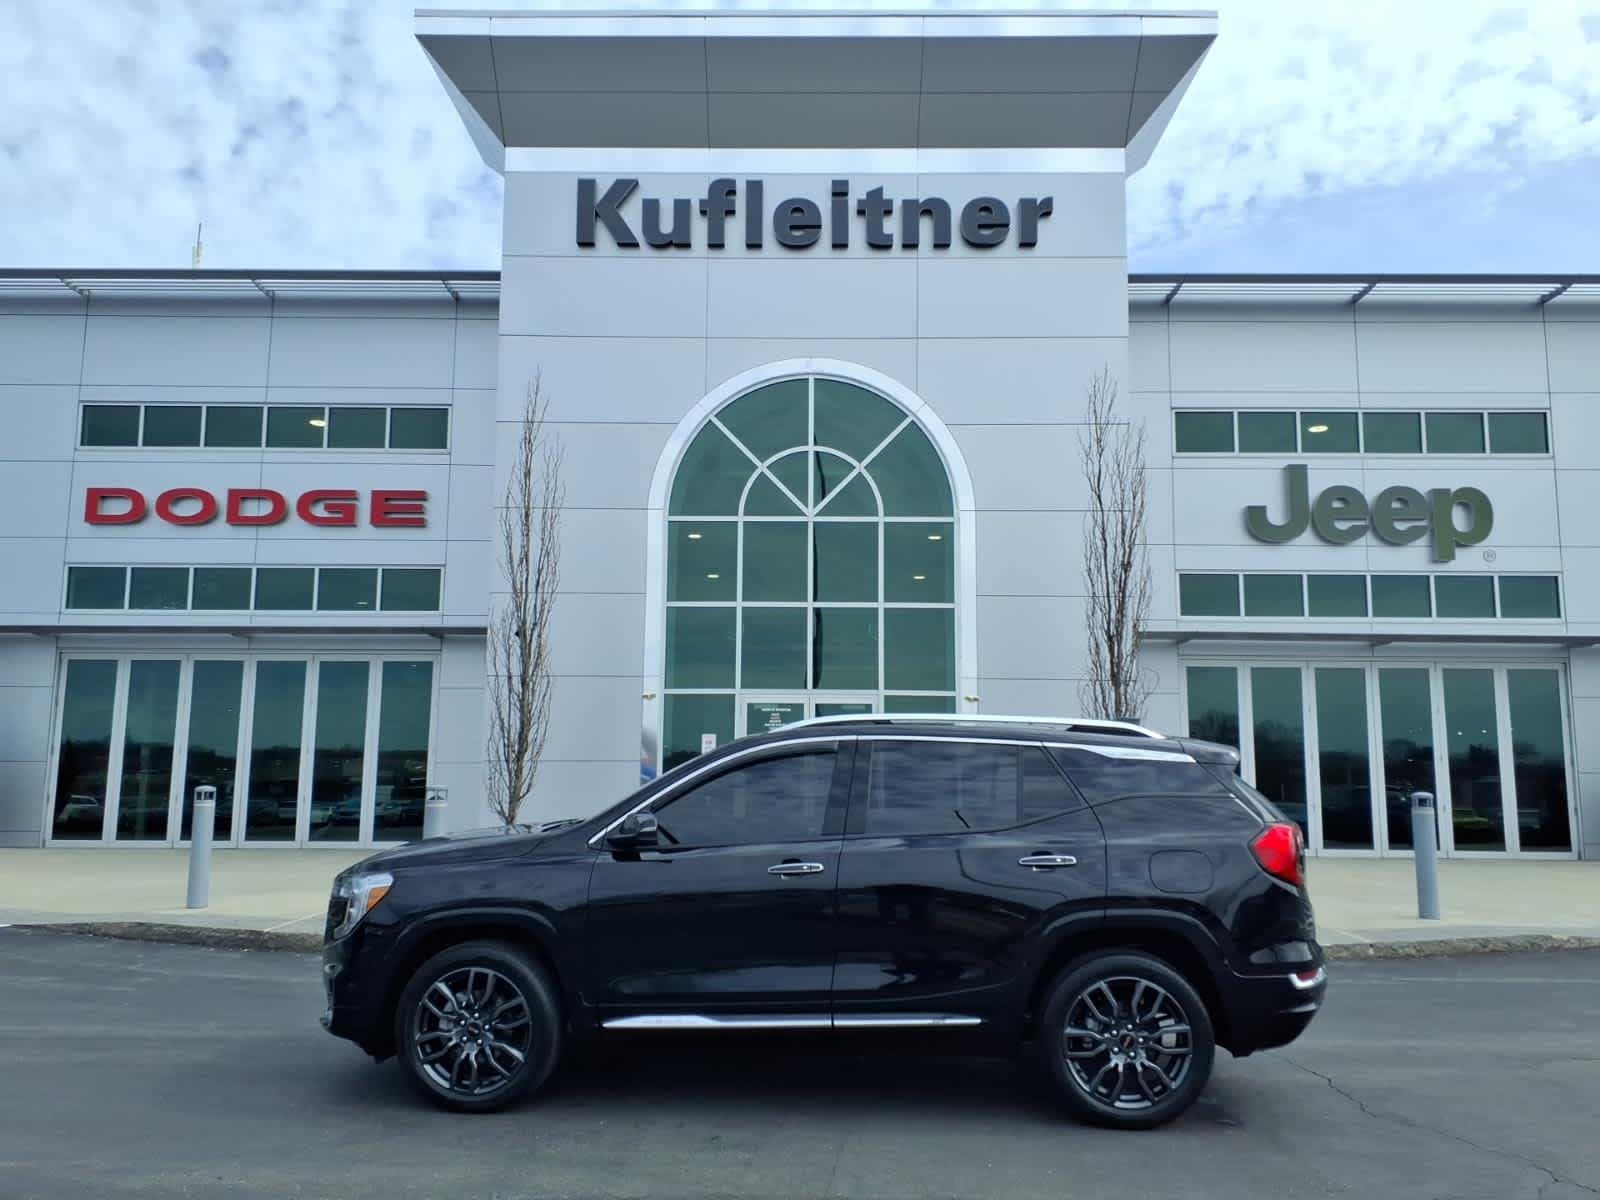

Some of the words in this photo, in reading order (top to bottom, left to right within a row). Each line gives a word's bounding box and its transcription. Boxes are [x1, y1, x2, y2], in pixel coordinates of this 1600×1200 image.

[576, 178, 1053, 250] Kufleitner
[84, 487, 427, 528] DODGE
[1243, 464, 1494, 563] Jeep
